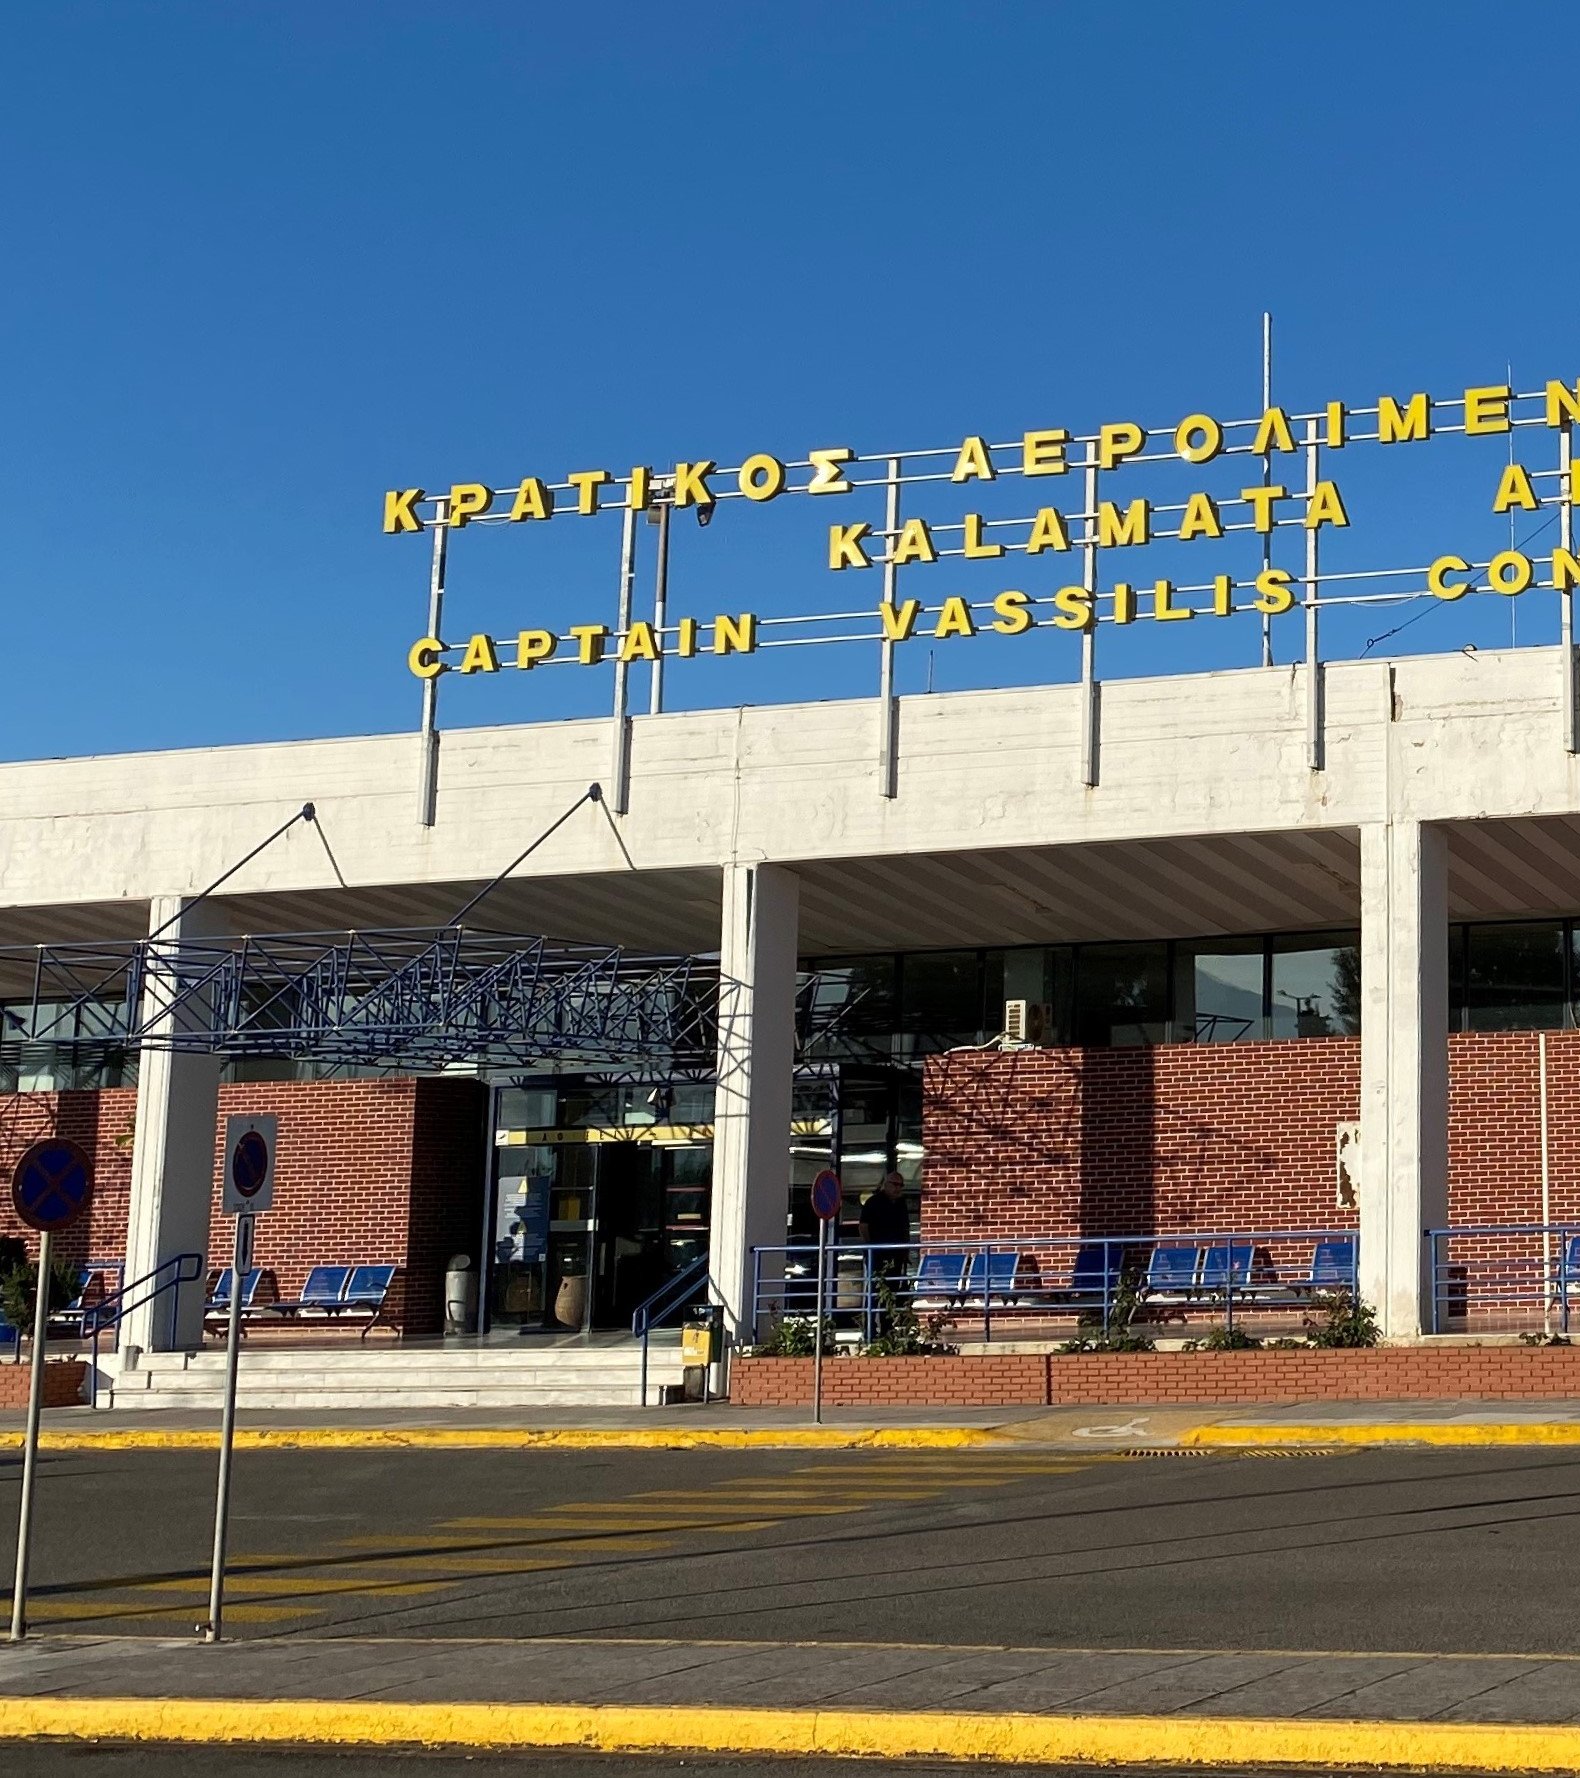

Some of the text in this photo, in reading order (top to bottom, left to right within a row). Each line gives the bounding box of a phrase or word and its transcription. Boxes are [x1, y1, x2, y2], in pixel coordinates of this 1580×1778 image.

[383, 448, 855, 534] ΚΡΑΤΙΚΟΣ
[829, 480, 1349, 570] KALAMATA
[407, 612, 758, 680] CAPTAIN
[879, 569, 1295, 642] VASSILIS
